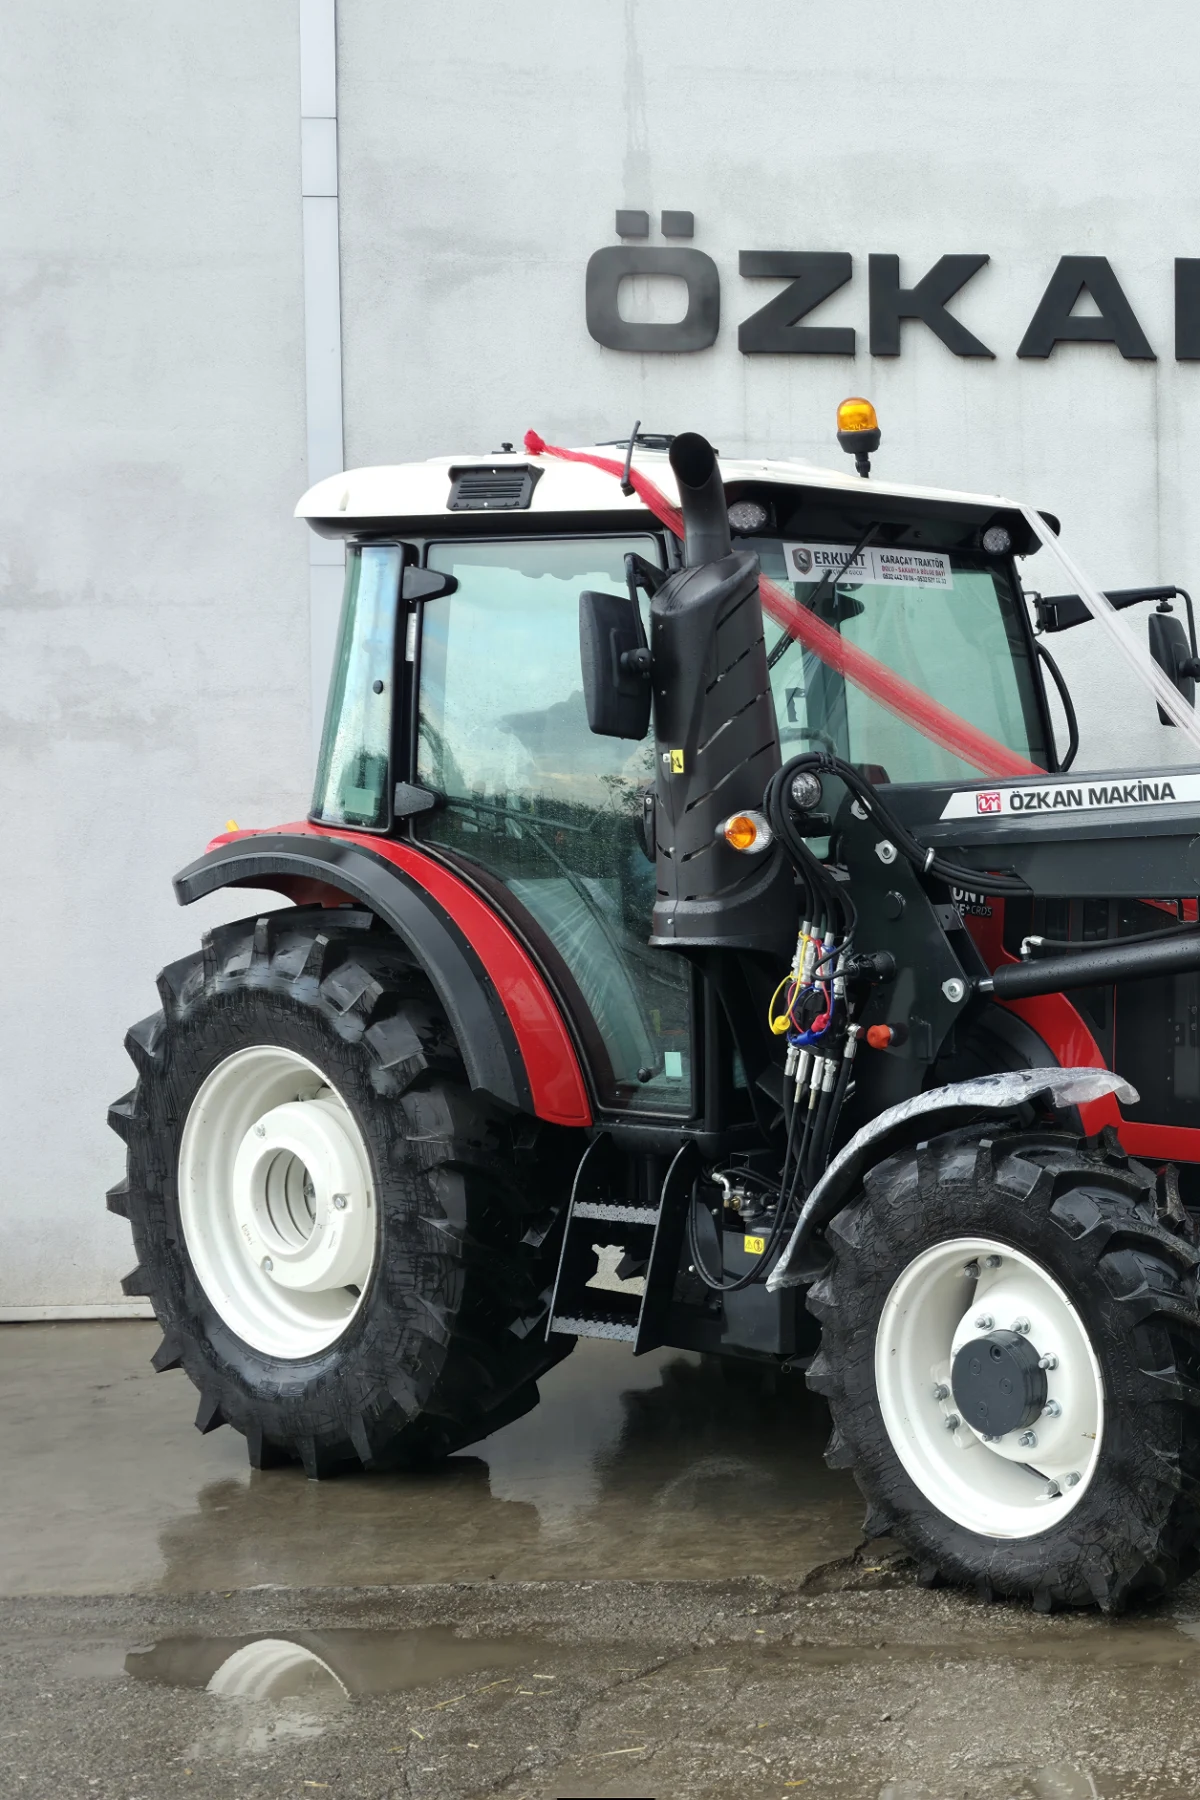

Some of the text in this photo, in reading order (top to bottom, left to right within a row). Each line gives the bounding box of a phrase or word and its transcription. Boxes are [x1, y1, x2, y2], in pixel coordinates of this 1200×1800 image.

[880, 554, 944, 568] KARAÇAY TRAKTÖR
[1009, 788, 1083, 812] ÖZKAN
[1088, 780, 1177, 806] MAKİNA
